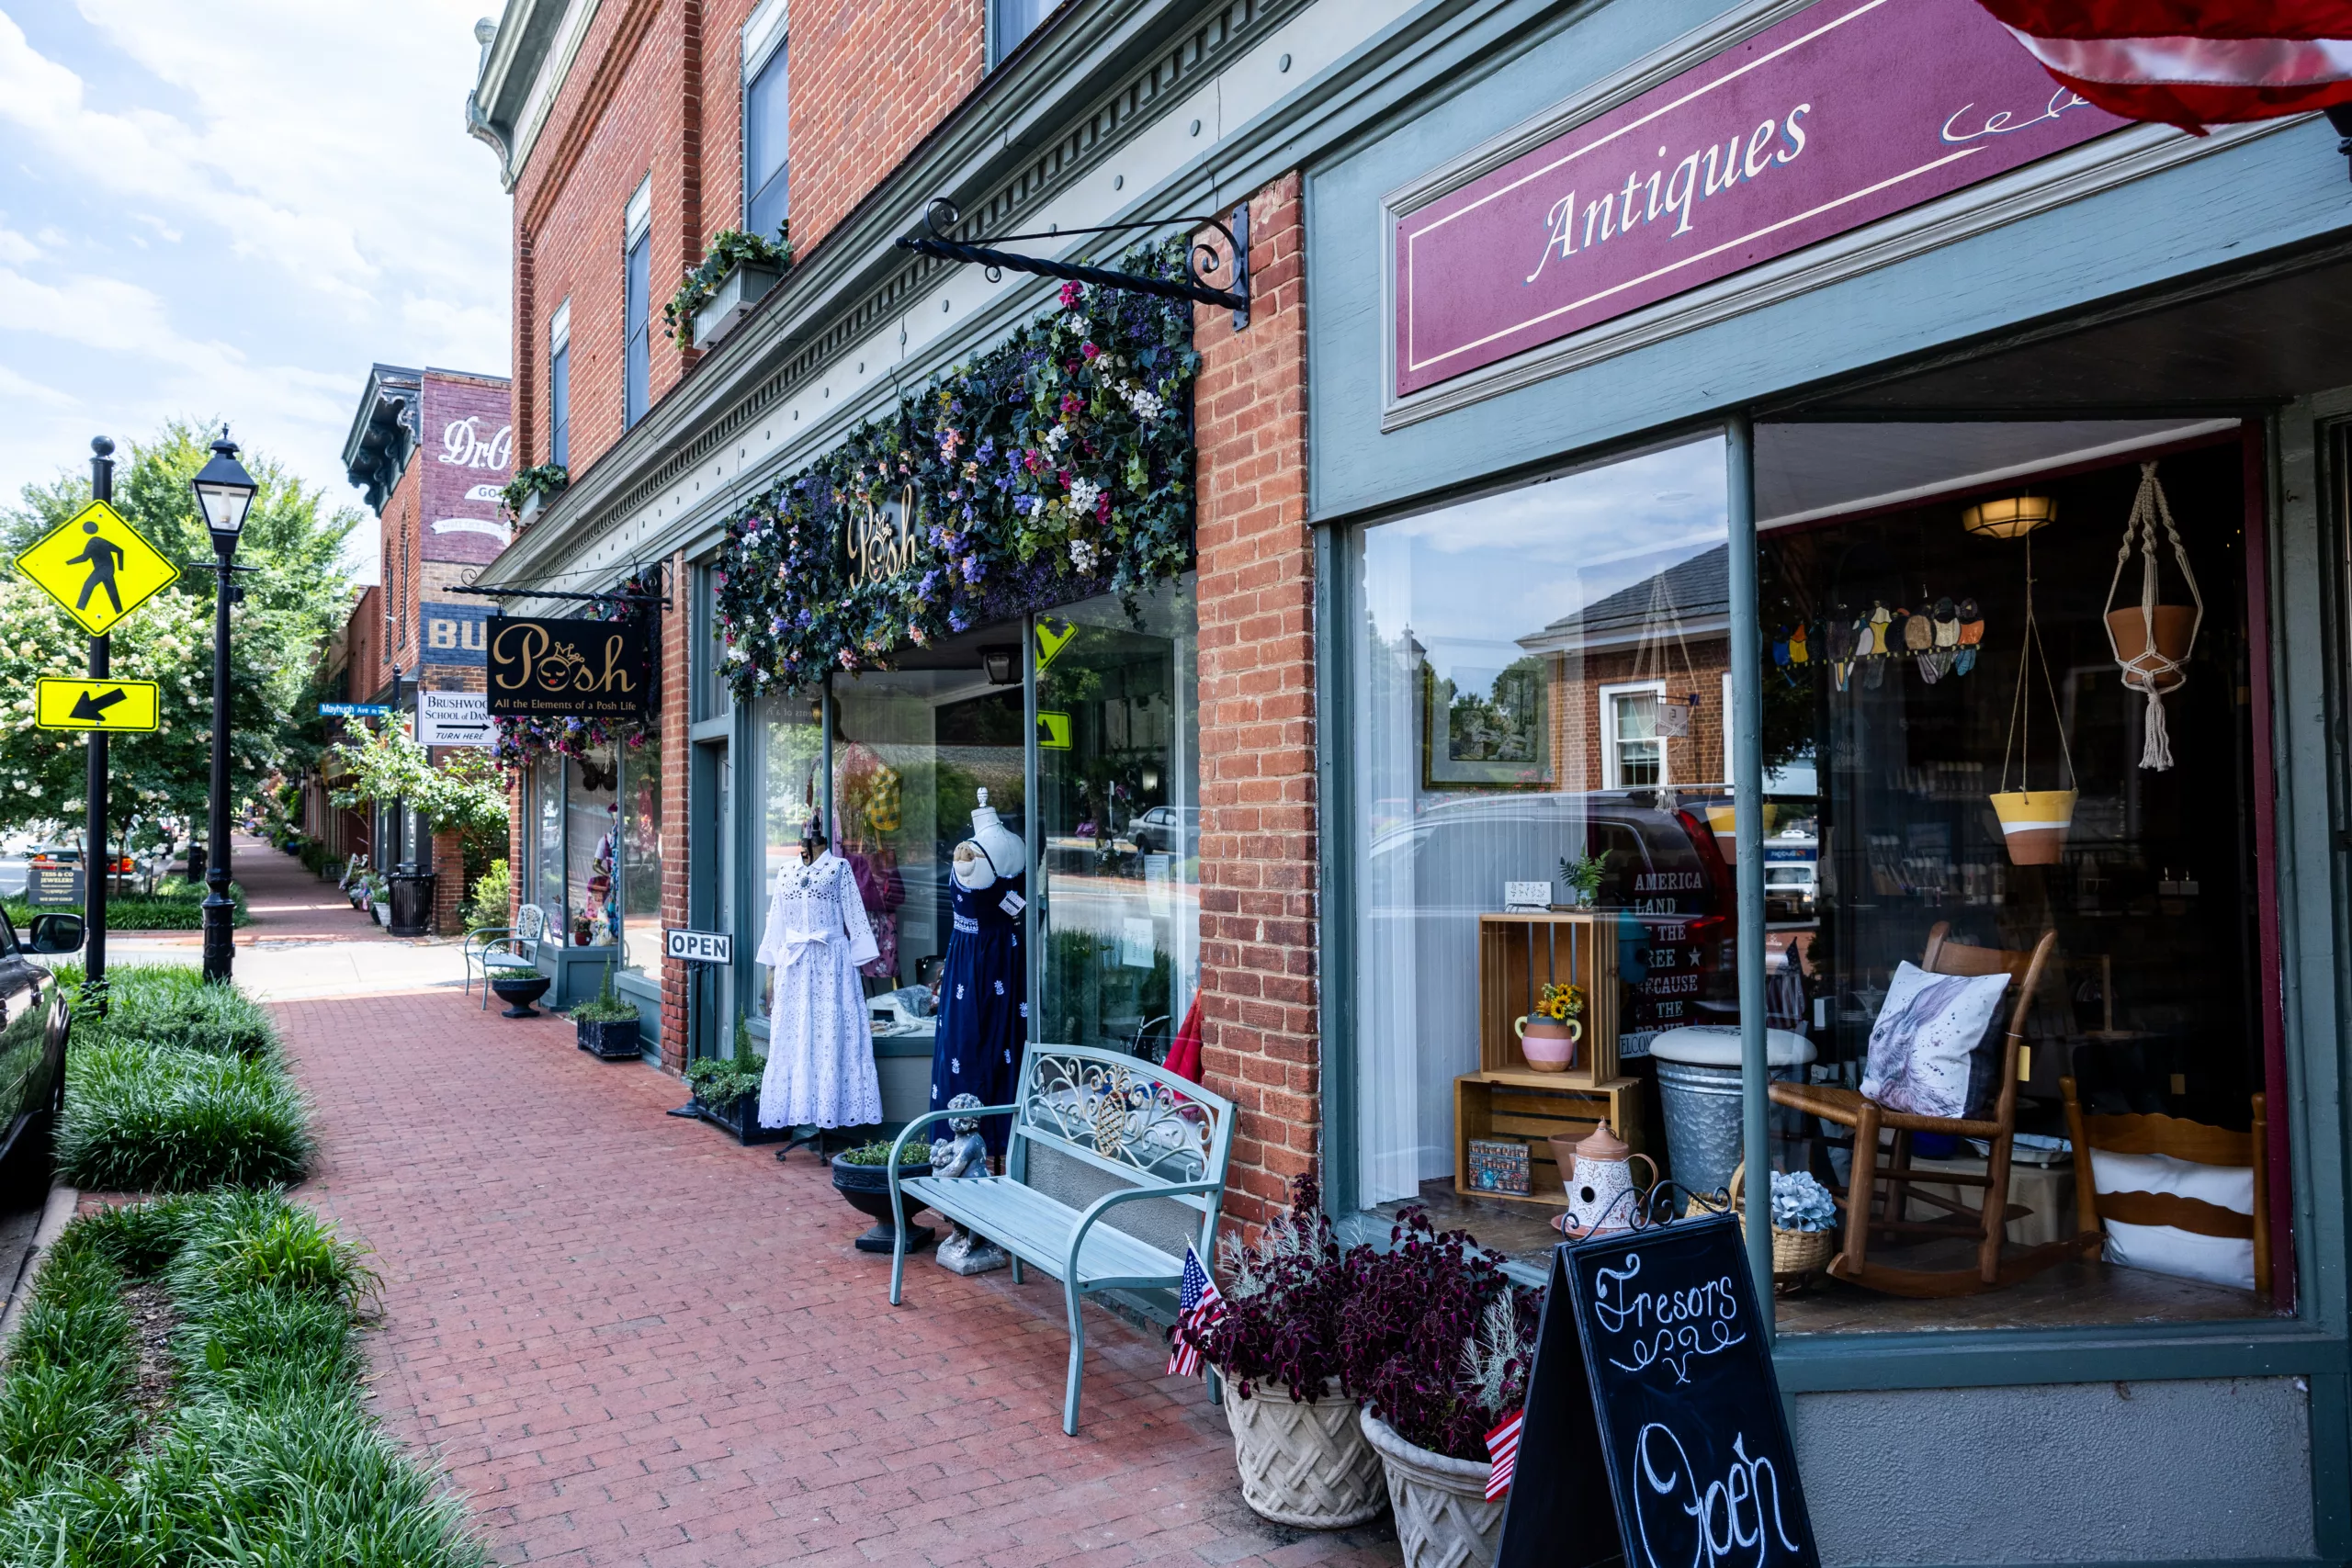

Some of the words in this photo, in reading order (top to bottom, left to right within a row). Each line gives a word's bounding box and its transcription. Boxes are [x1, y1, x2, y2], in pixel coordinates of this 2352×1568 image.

[1524, 103, 1812, 284] Antiques
[478, 487, 498, 498] GO
[847, 483, 917, 590] Posh
[428, 618, 487, 651] BU
[492, 623, 637, 693] Posh
[427, 695, 488, 709] BRUSHWOO
[494, 699, 510, 708] All
[513, 699, 528, 708] the
[531, 700, 572, 709] Elements
[576, 700, 585, 710] of
[596, 701, 617, 710] Posh
[620, 702, 637, 711] Life
[424, 710, 460, 719] SCHOOL
[469, 711, 494, 721] DANC
[1634, 873, 1702, 891] AMERICA
[1635, 897, 1676, 916] LAND
[1657, 925, 1686, 942] THE
[672, 934, 727, 958] OPEN
[1656, 1000, 1683, 1018] THE
[1620, 1034, 1658, 1055] ELCOM
[1594, 1253, 1737, 1333] Tresors
